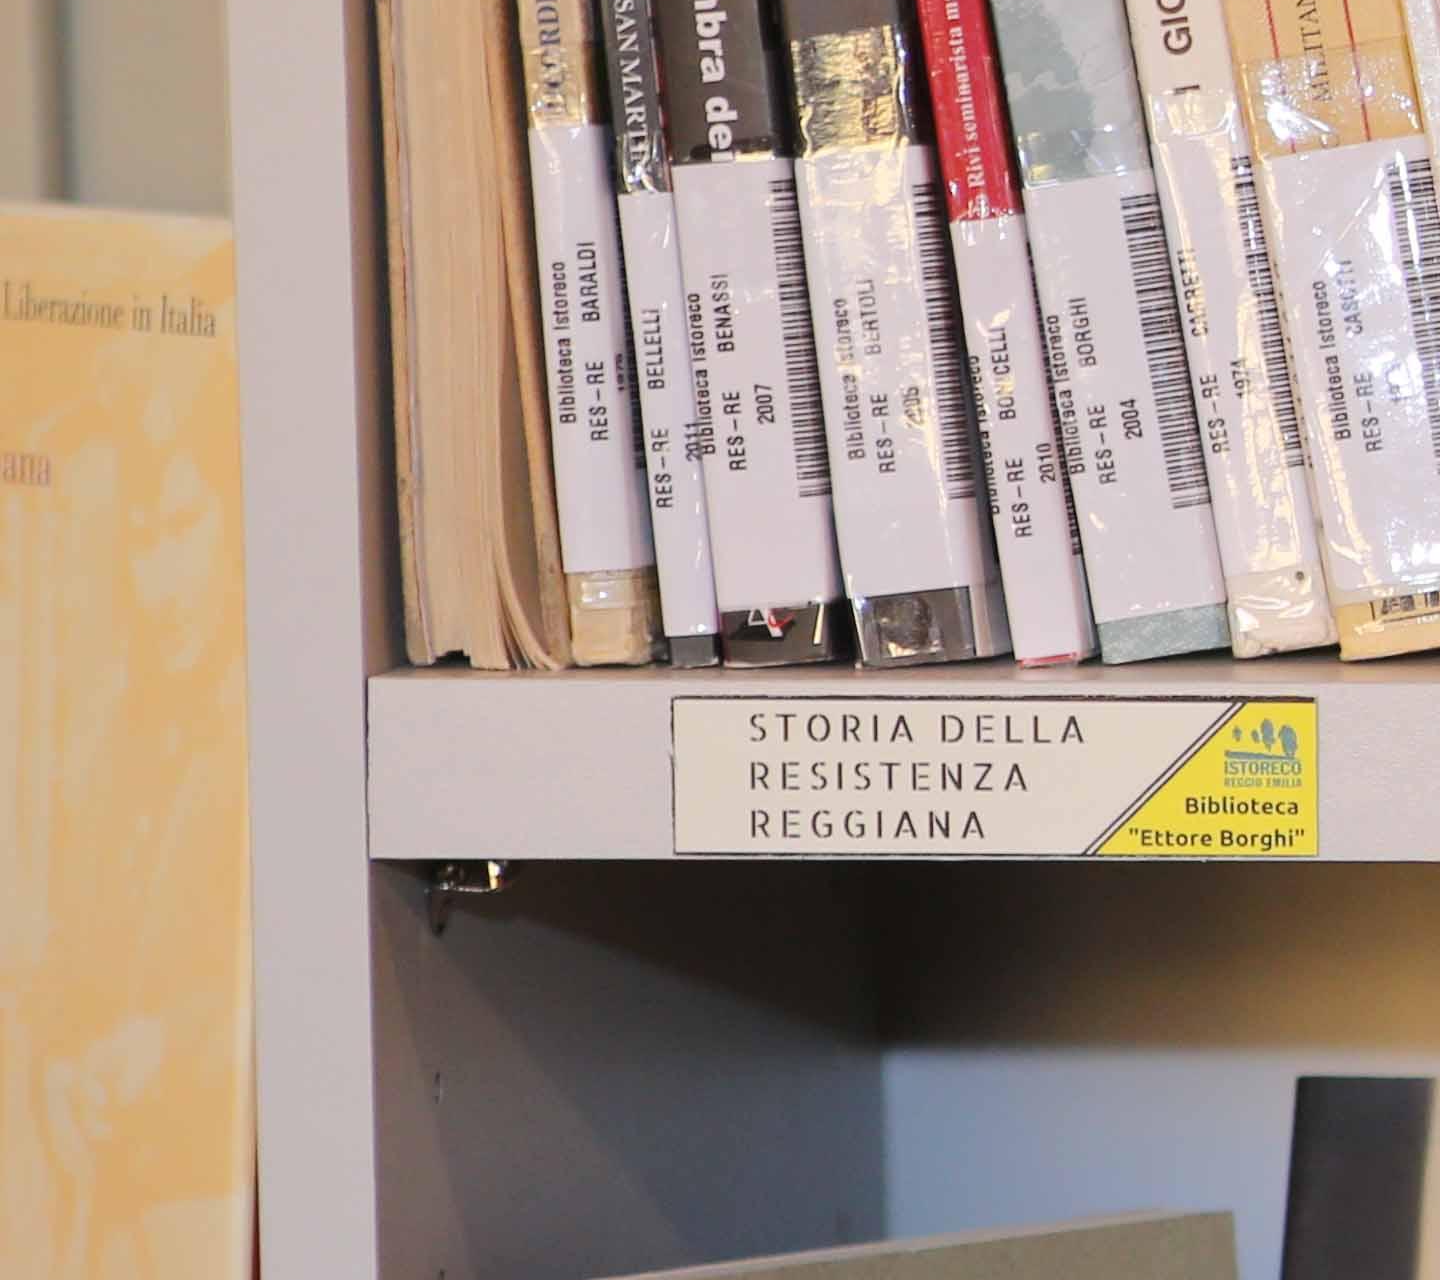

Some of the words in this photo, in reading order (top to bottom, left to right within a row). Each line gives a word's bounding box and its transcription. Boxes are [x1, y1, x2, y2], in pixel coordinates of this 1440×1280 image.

[579, 241, 602, 322] BARALDI
[2, 281, 125, 329] Liberazione
[132, 293, 153, 330] in
[159, 296, 217, 338] Italia
[713, 273, 736, 352] BENASSI
[1069, 296, 1096, 367] BORGHI
[749, 713, 912, 744] STORIA
[941, 713, 1086, 743] DELLA
[749, 761, 1029, 792] RESISTENZA
[1224, 761, 1302, 776] ISTORECO
[1185, 796, 1300, 816] Biblioteca
[750, 809, 985, 839] REGGIANA
[1129, 828, 1216, 848] "Ettore
[1220, 828, 1305, 852] Borghi"
